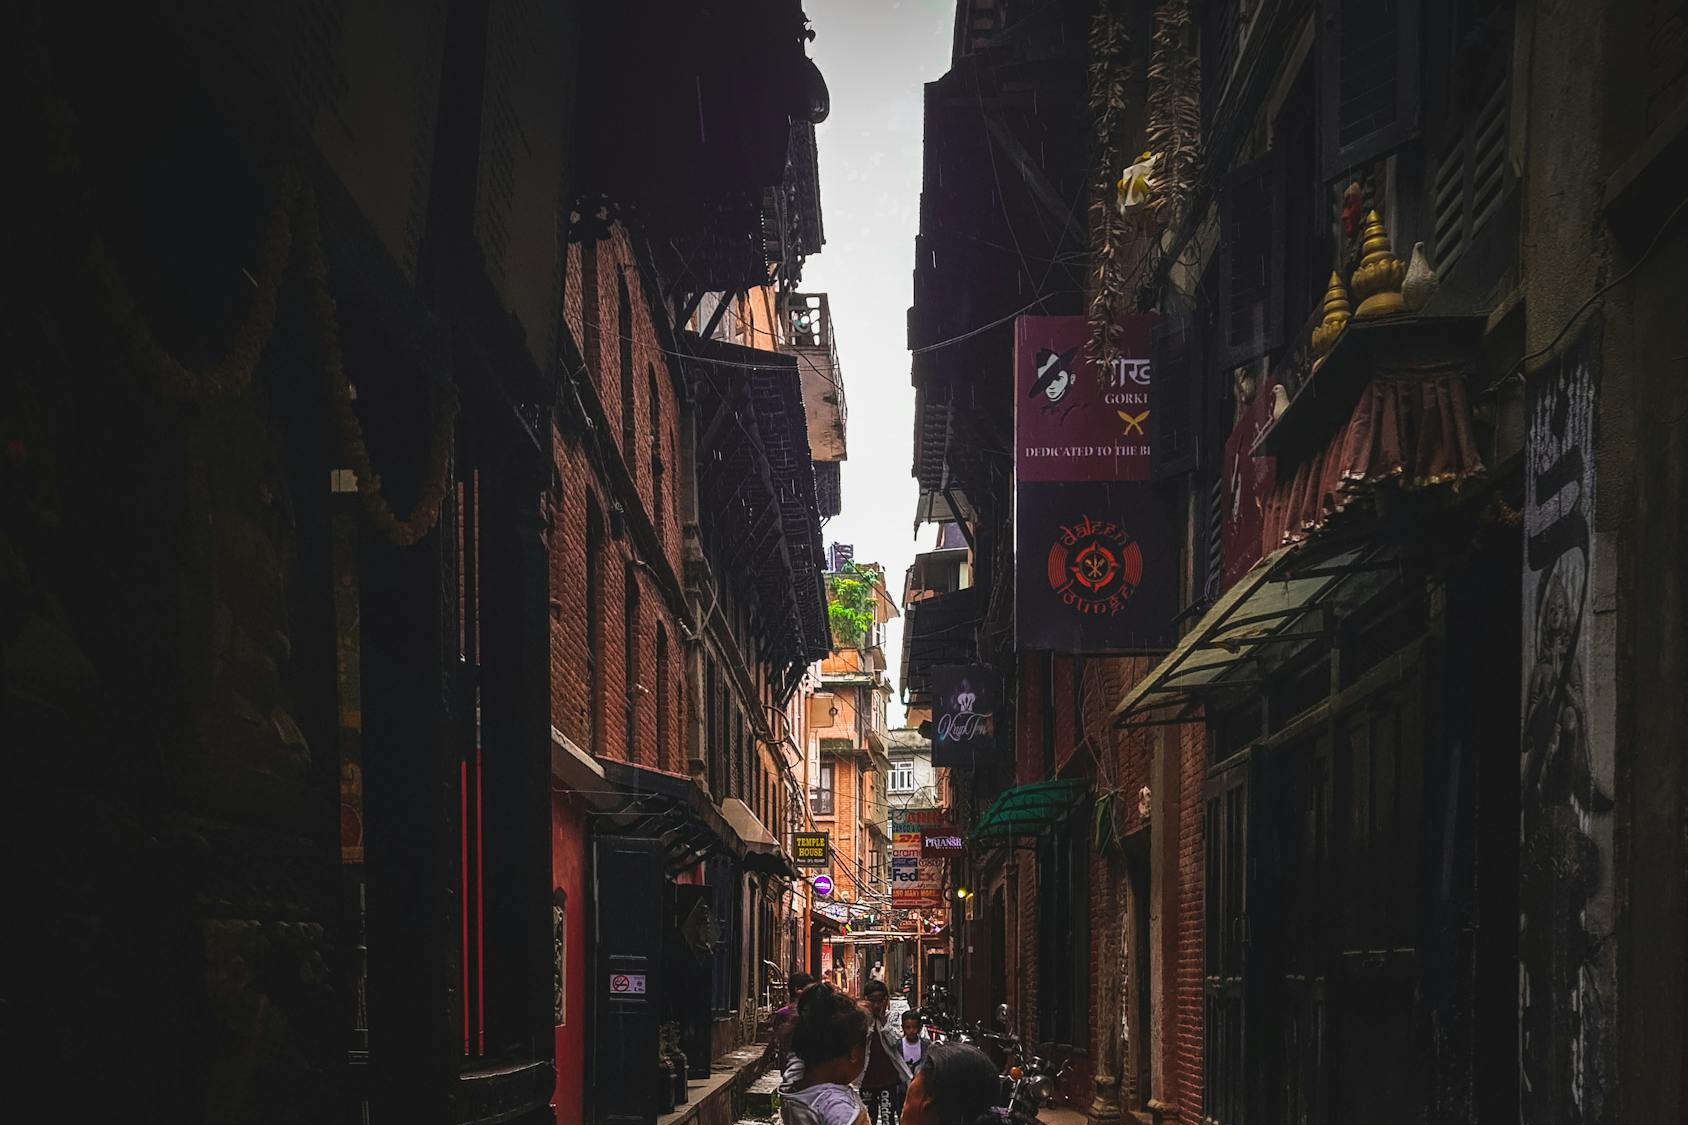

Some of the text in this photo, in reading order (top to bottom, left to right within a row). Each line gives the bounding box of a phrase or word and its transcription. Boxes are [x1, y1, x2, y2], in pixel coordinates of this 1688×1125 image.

[1025, 447, 1093, 457] DEDICATED
[1096, 446, 1112, 457] TO
[1115, 446, 1137, 456] THE
[796, 837, 825, 847] TEMPLE
[798, 848, 823, 857] HOUSE
[892, 849, 921, 857] aram
[892, 868, 938, 882] FedEx
